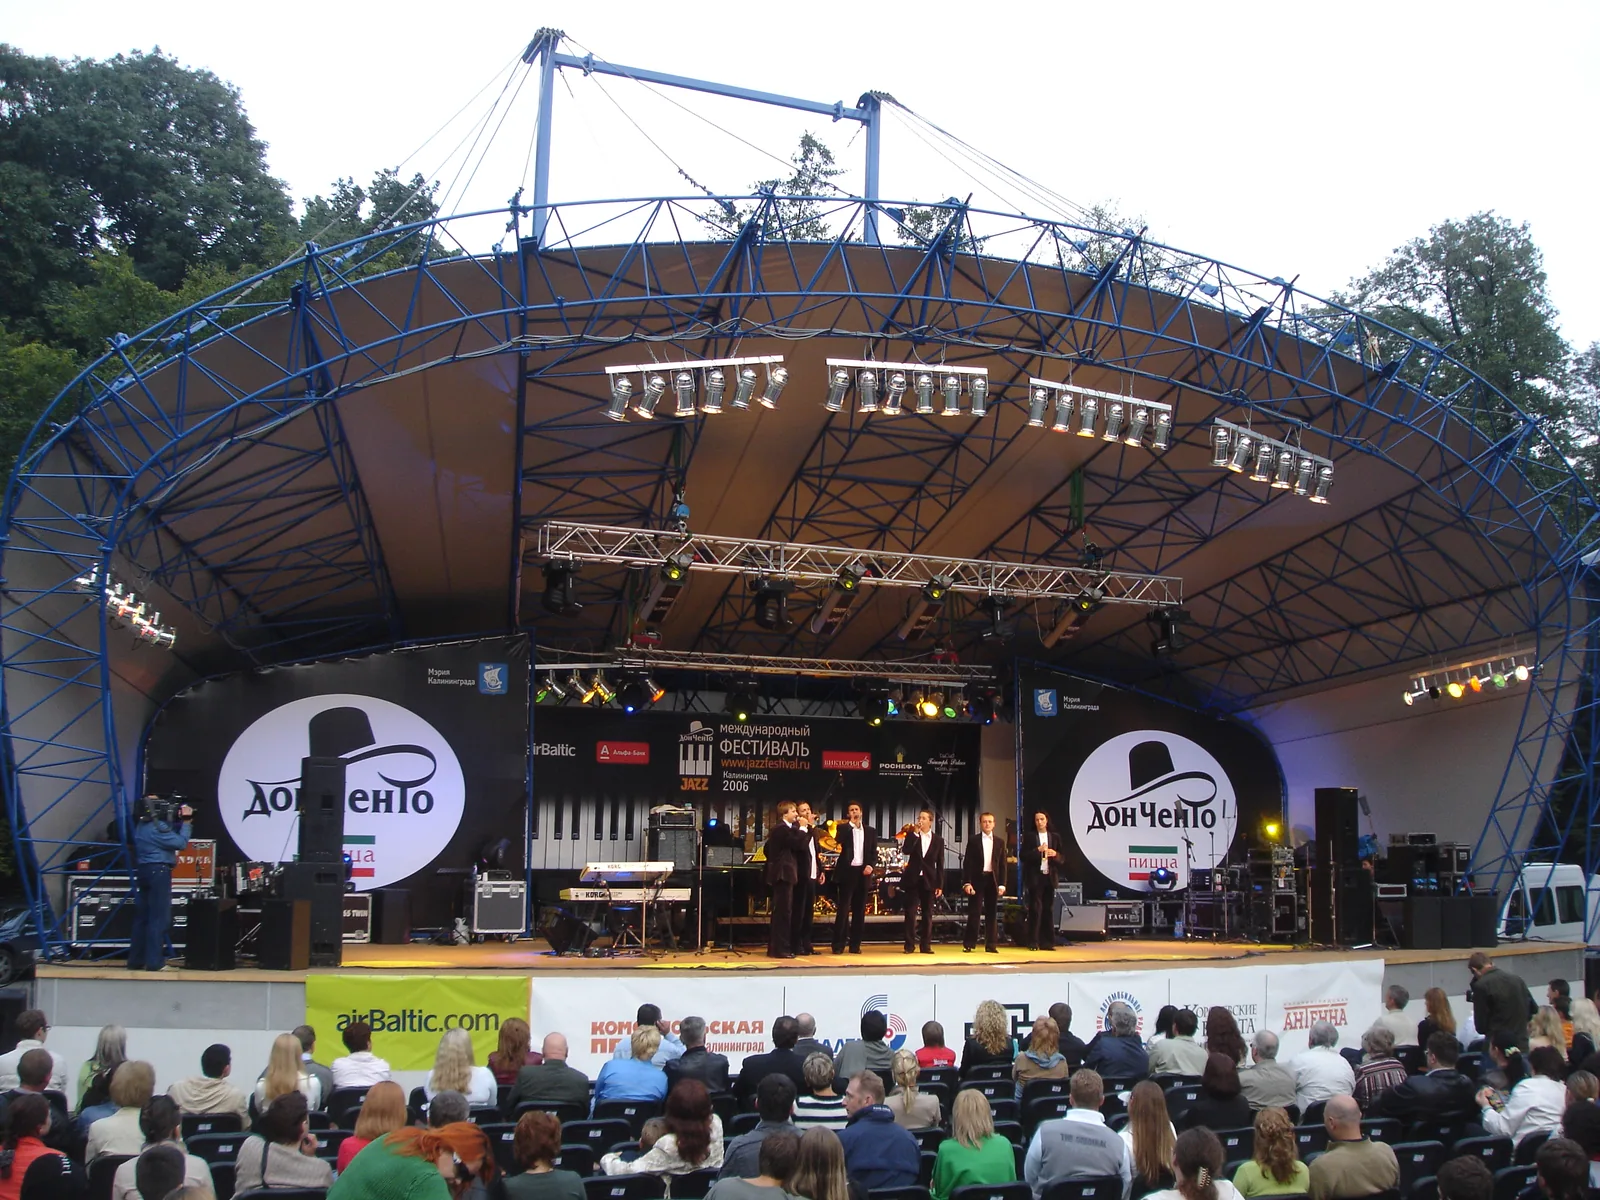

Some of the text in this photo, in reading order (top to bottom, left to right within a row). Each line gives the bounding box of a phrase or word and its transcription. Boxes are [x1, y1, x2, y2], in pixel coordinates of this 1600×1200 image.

[428, 668, 450, 677] Мэрия
[428, 677, 475, 686] Калининграда
[1063, 695, 1081, 703] Мэрия
[1063, 703, 1099, 711] Калининграда
[719, 724, 811, 738] международный
[719, 738, 810, 757] ФЕСТИВАЛЬ
[720, 757, 810, 770] www.jazzfestival.ru
[723, 771, 768, 781] Калининград
[680, 777, 709, 791] JAZZ
[722, 780, 749, 791] 2006
[1283, 1004, 1348, 1031] АНТЕННА
